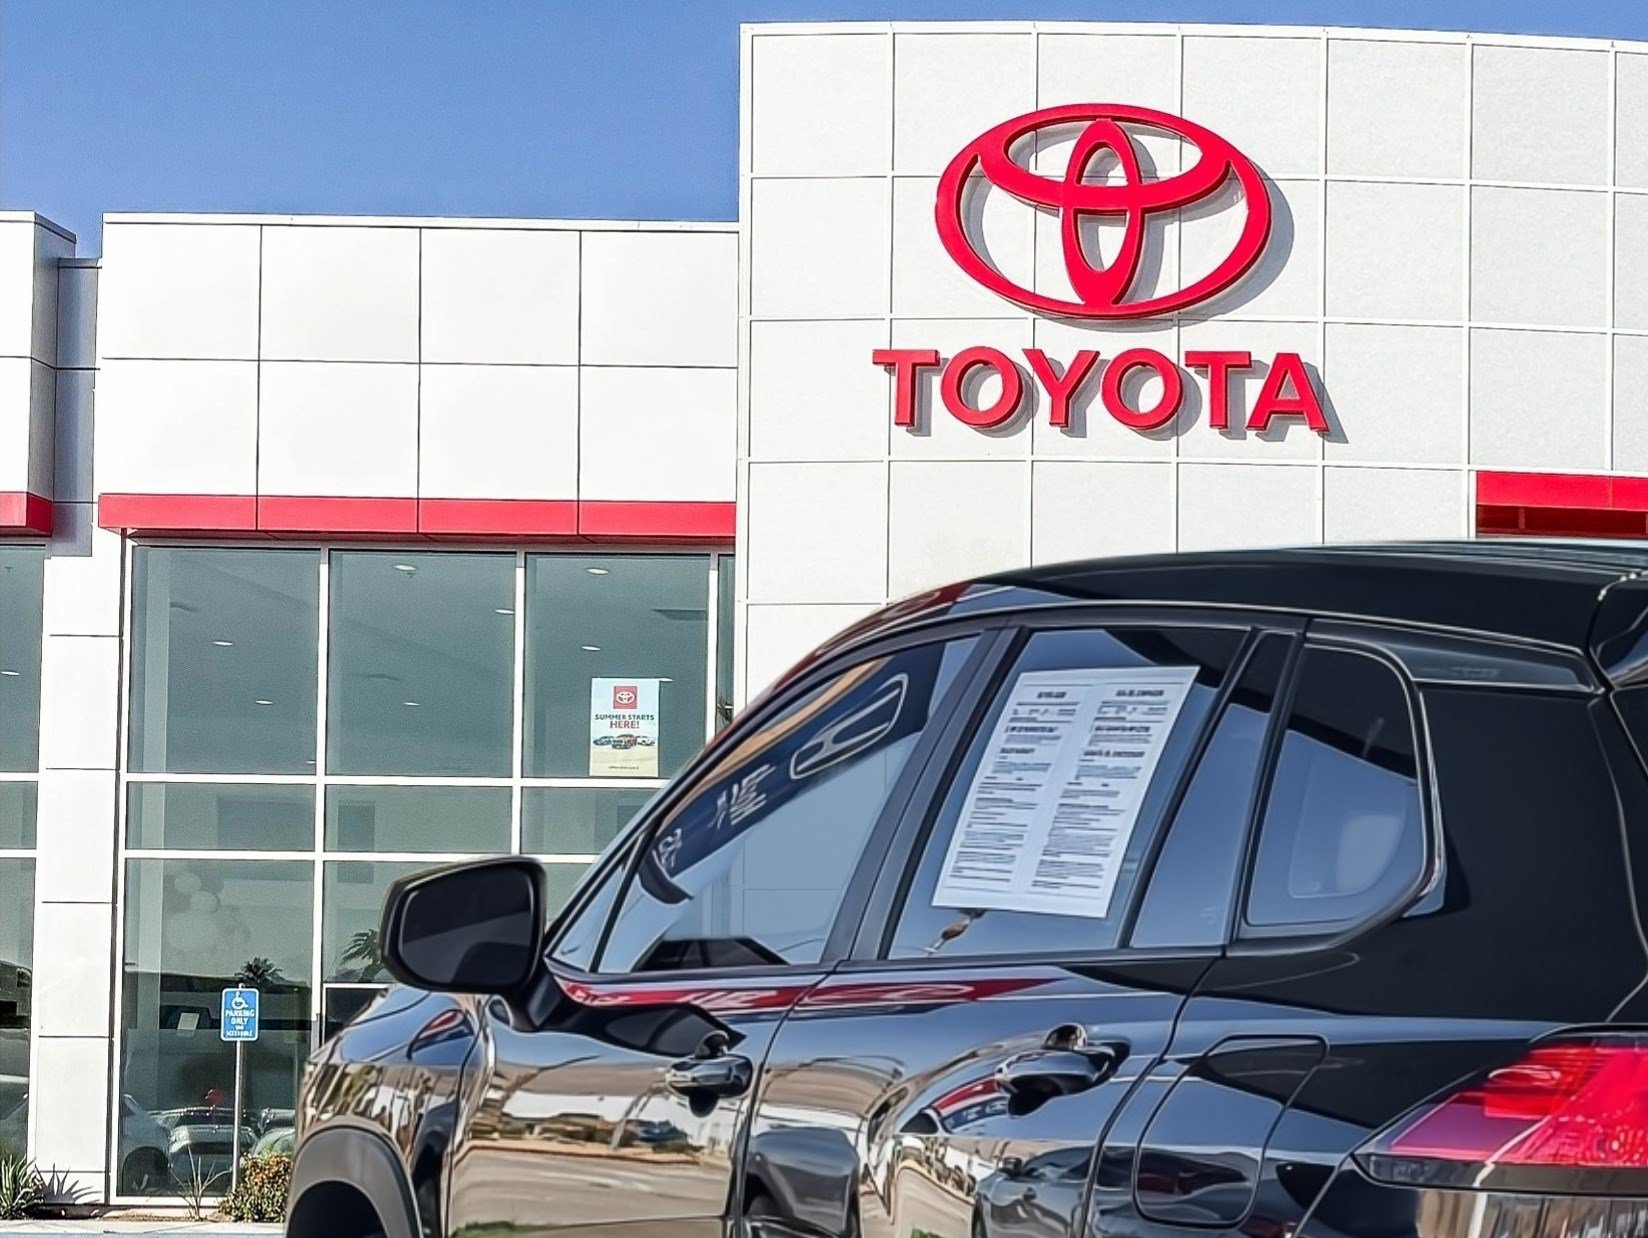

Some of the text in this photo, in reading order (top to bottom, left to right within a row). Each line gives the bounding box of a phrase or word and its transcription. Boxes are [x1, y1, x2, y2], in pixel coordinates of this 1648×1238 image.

[872, 346, 1330, 433] TOYOTA
[609, 720, 640, 730] HERE!
[225, 1009, 255, 1017] PARKING
[231, 1017, 249, 1025] ONLY
